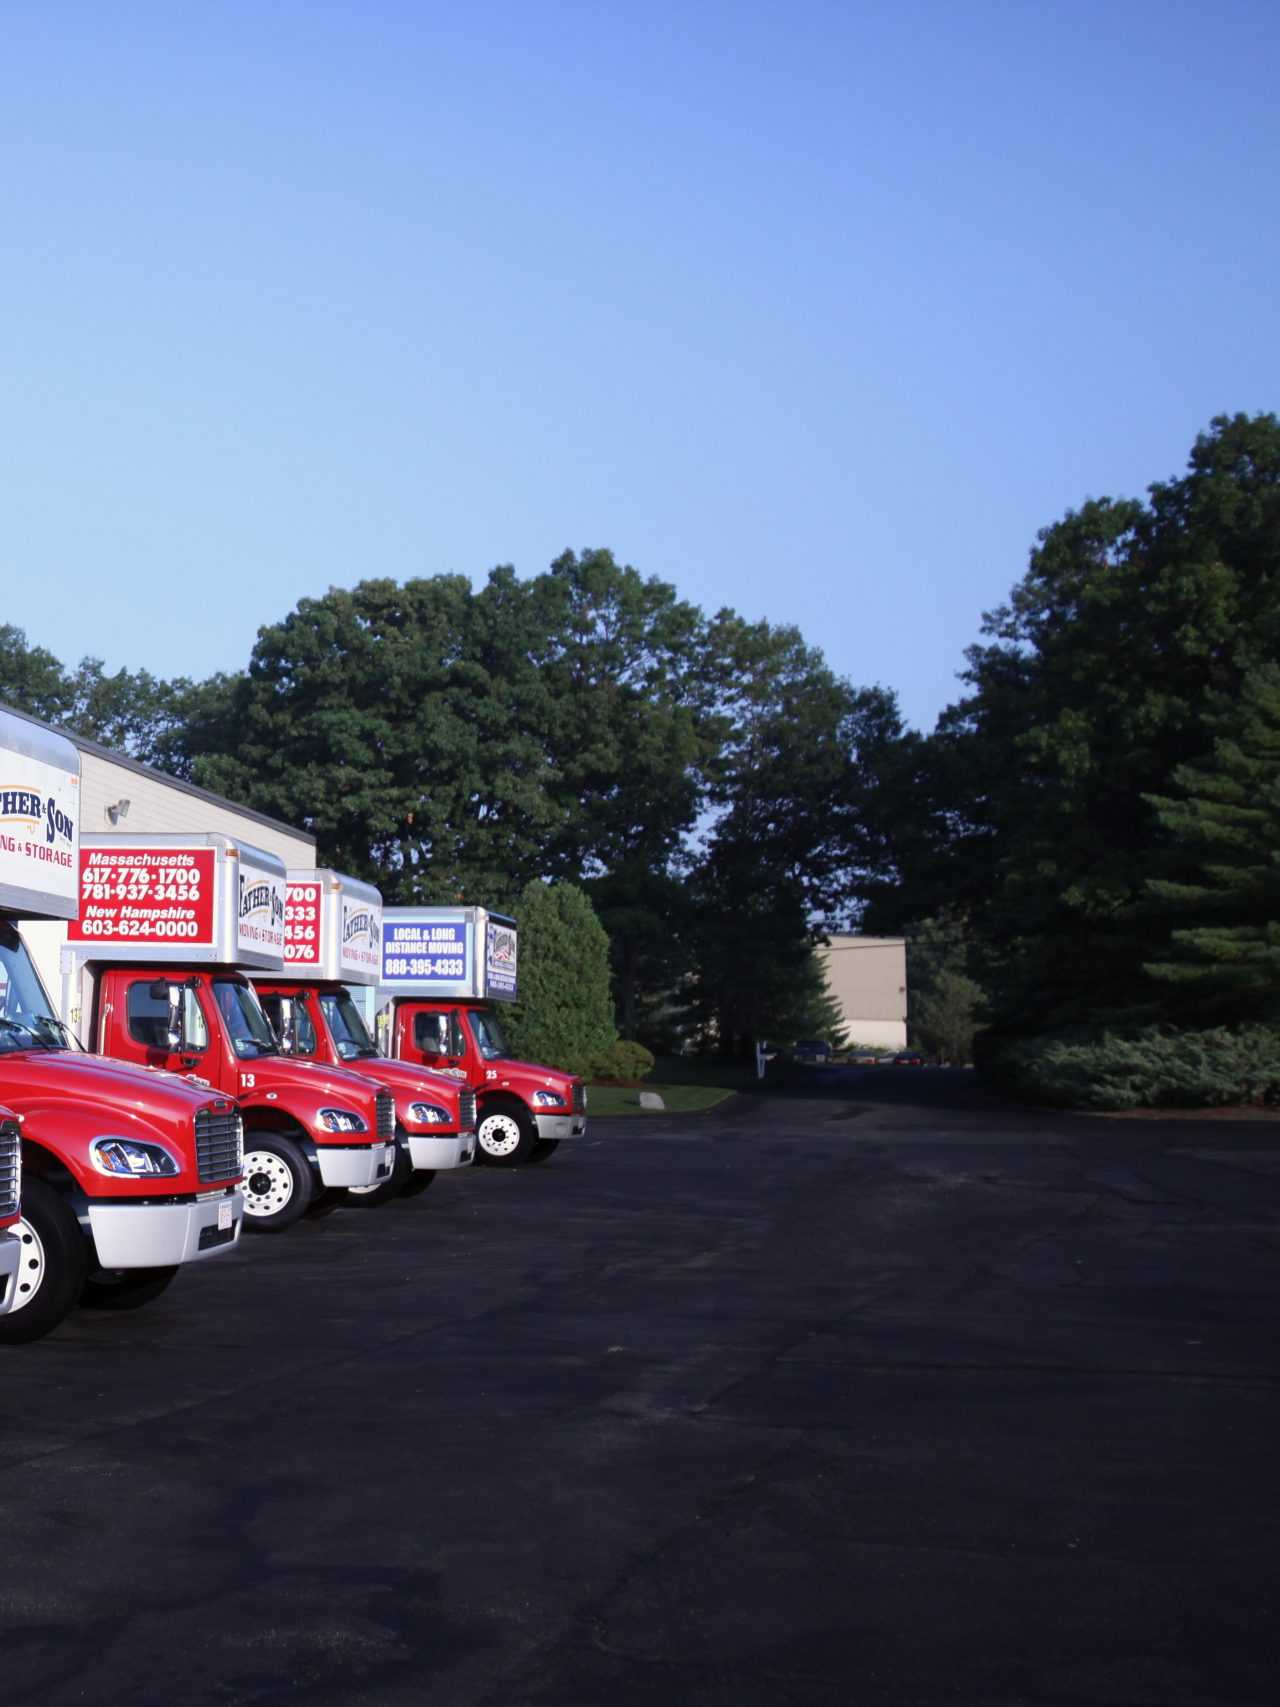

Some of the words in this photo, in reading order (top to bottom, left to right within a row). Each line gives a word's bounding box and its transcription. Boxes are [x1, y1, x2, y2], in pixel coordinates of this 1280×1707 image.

[47, 797, 73, 843] SON
[25, 841, 73, 868] STORAGE
[89, 853, 195, 866] Massachusetts
[286, 887, 317, 902] 700
[86, 906, 118, 918] New
[120, 906, 195, 920] Hampshire
[285, 906, 316, 921] 333
[82, 920, 199, 936] 603-624-0000
[285, 925, 316, 940] 456
[394, 928, 421, 941] LOCAL
[431, 928, 456, 941] LONG
[284, 944, 315, 959] 076
[385, 942, 428, 954] DISTANCE
[428, 942, 464, 954] MOVING
[385, 959, 463, 975] 888-395-4333
[241, 1073, 255, 1087] 13
[486, 1070, 497, 1080] 25
